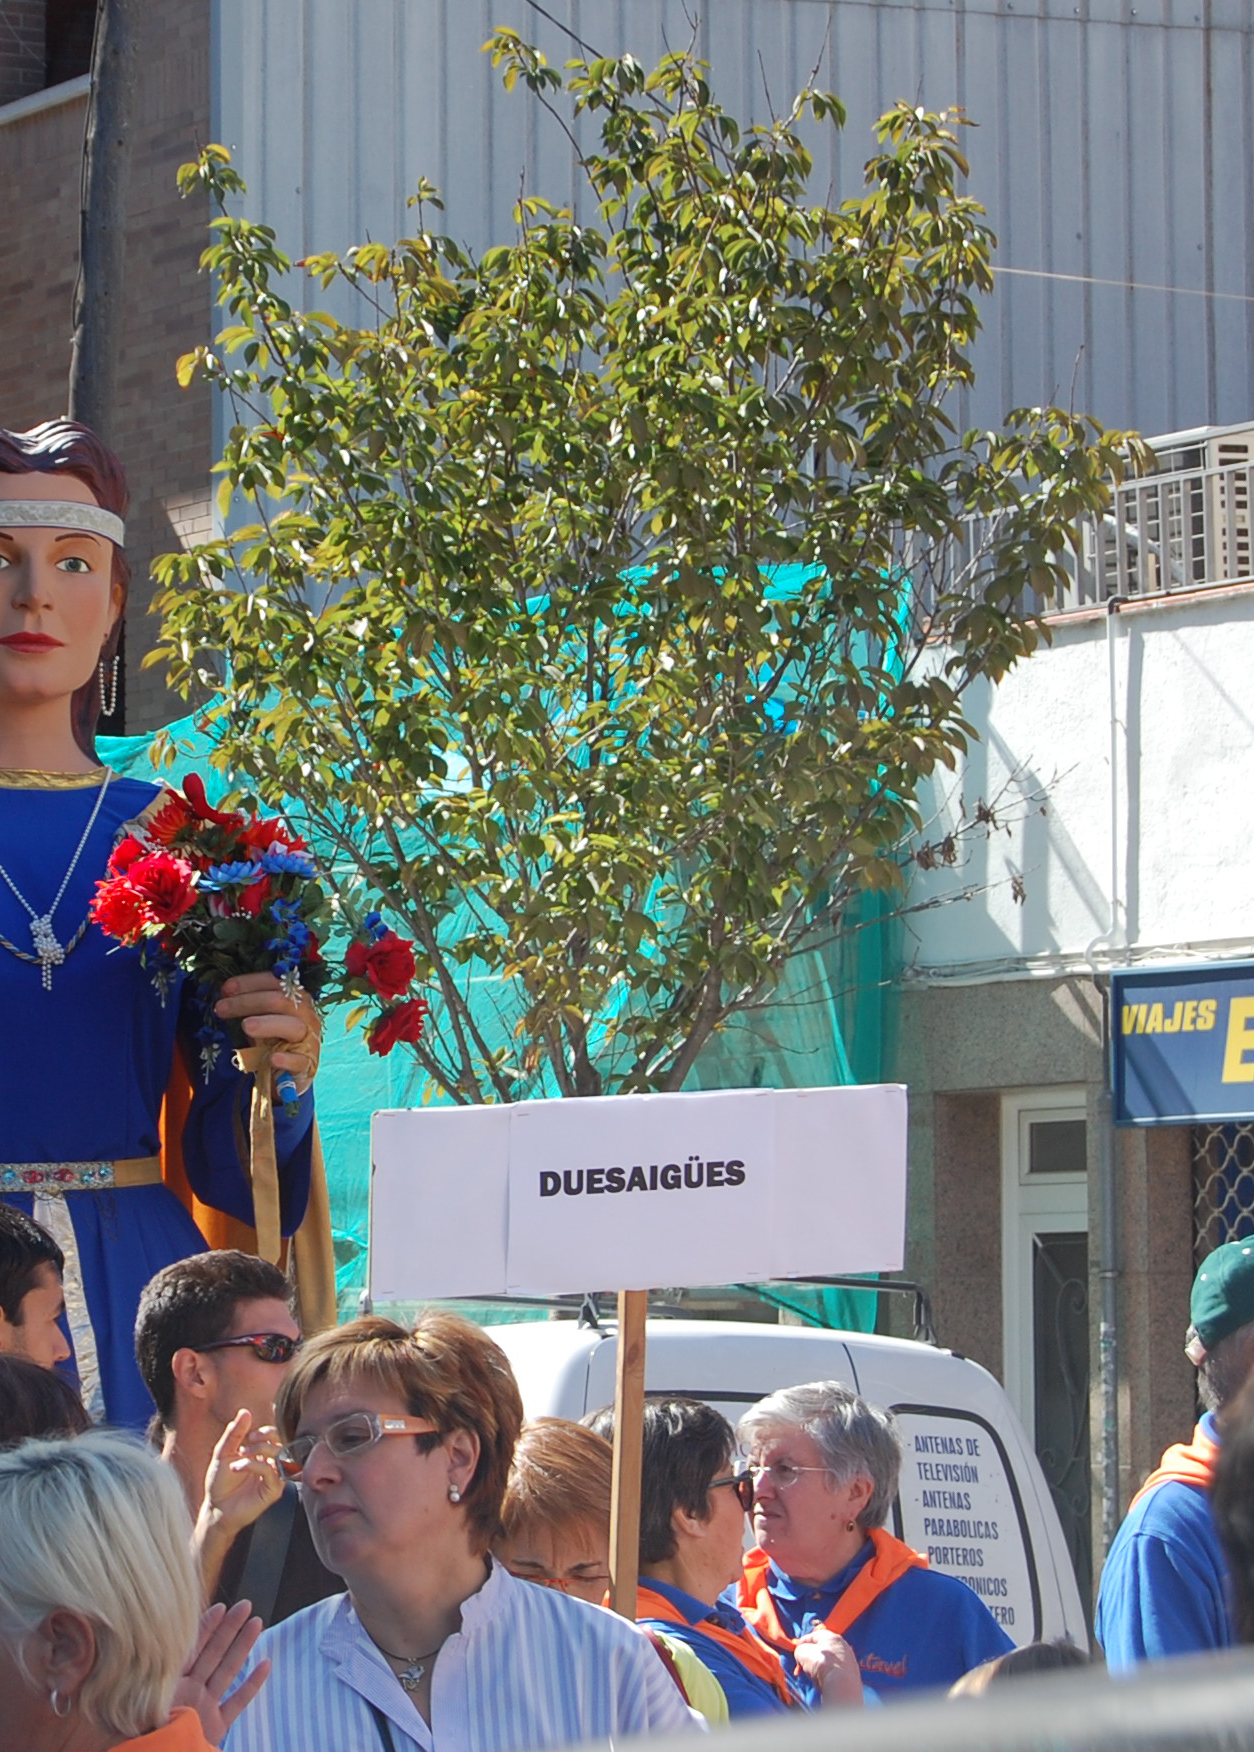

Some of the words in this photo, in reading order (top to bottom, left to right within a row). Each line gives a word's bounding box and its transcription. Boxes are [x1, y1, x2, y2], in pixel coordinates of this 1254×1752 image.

[1122, 998, 1217, 1035] VIAJES
[539, 1155, 746, 1197] DUESAIGÜES
[914, 1435, 964, 1456] ANTENAS
[965, 1438, 981, 1457] DE
[917, 1461, 979, 1484] TELEVISIÓN
[922, 1489, 972, 1511] ANTENAS
[924, 1517, 999, 1540] PARABOLICAS
[927, 1545, 984, 1567] PORTEROS
[956, 1575, 1008, 1597] ONICOS
